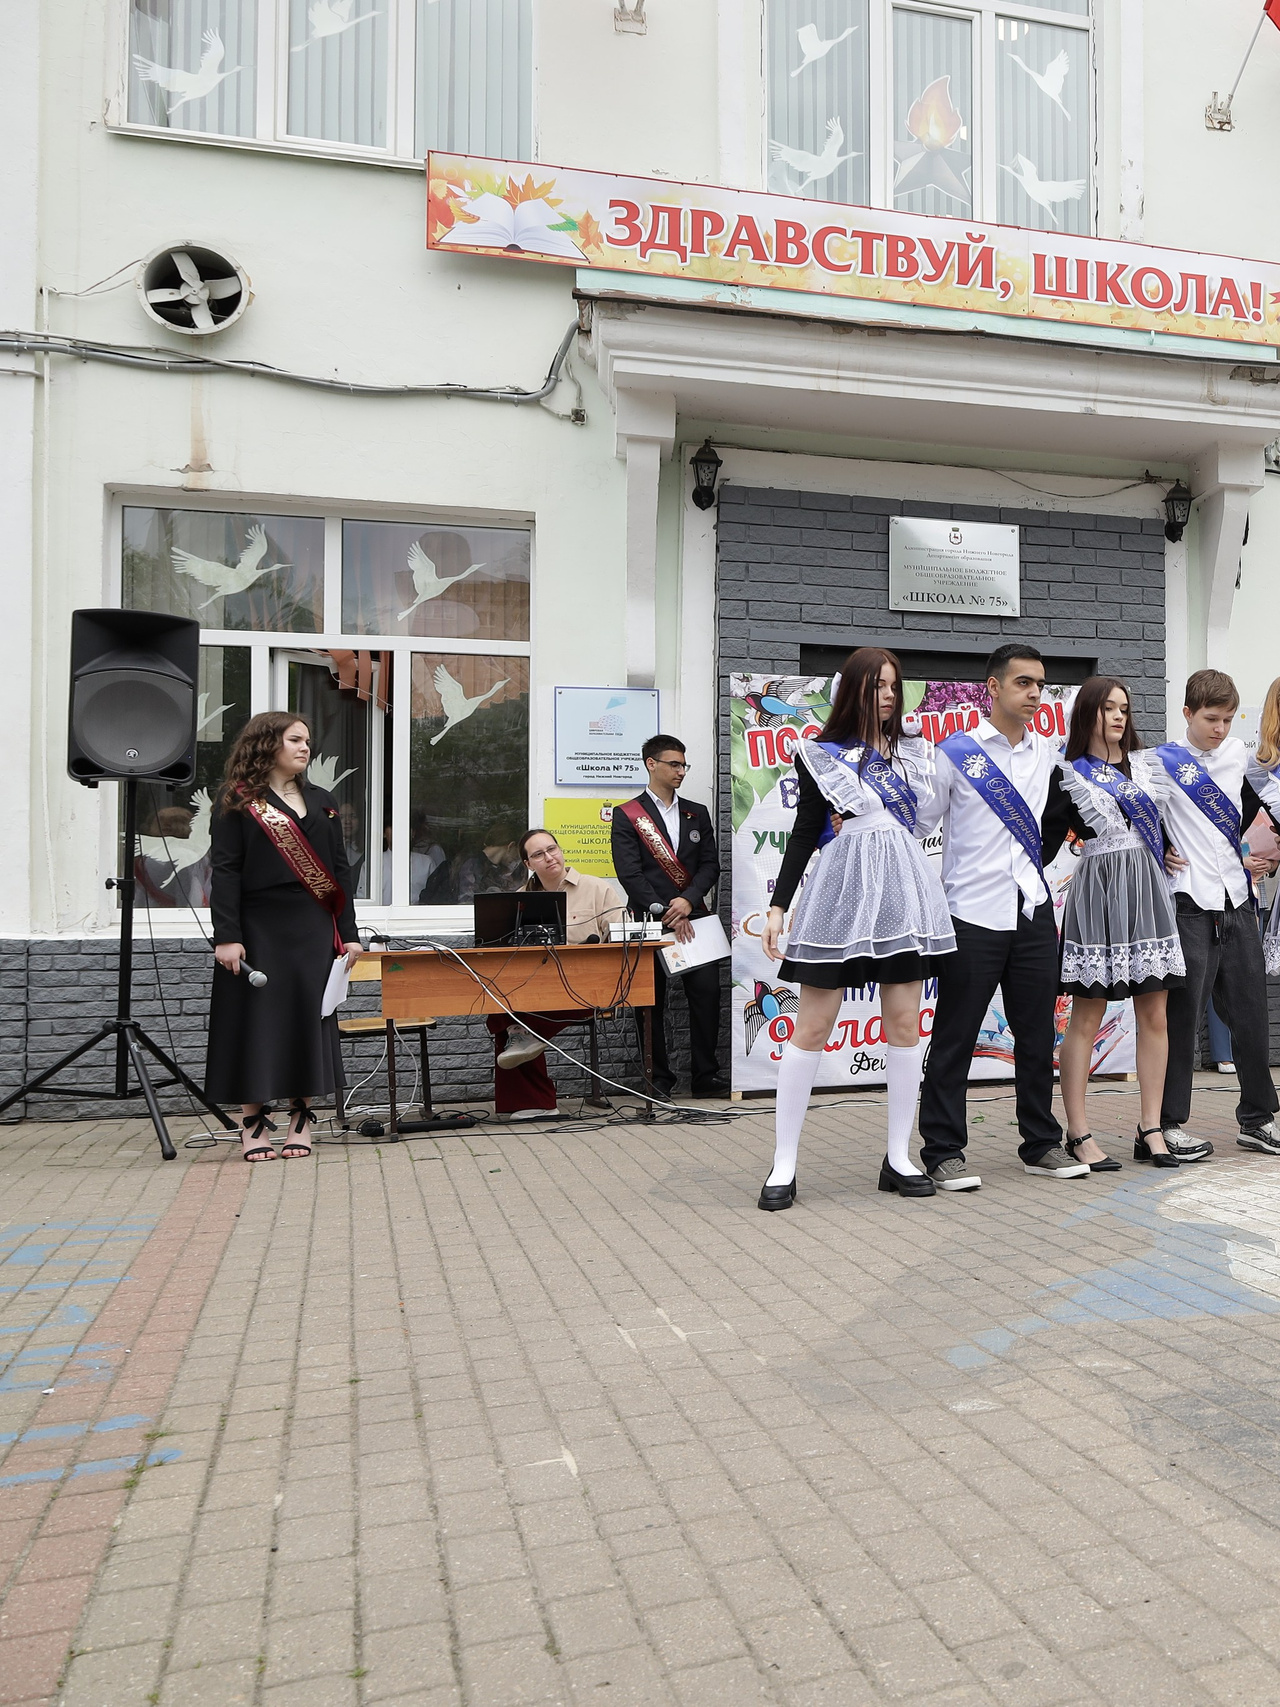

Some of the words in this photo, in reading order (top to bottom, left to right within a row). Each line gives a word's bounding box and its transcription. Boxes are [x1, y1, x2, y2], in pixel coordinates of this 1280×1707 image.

[604, 198, 1012, 300] ЗДРАВСТВУЙ,
[1032, 252, 1263, 323] ШКОЛА!
[915, 571, 996, 581] ОБЩЕОБРАЗОВАТЕЛЬНОЕ
[965, 568, 1007, 576] БЮДЖЕТНОЕ
[933, 579, 978, 587] УЧРЕЖДЕНИЕ
[902, 591, 966, 605] «ШКОЛА
[969, 595, 986, 606] №
[989, 596, 1008, 607] 75»
[624, 764, 640, 772] 75»
[986, 777, 1037, 846] Выпускник
